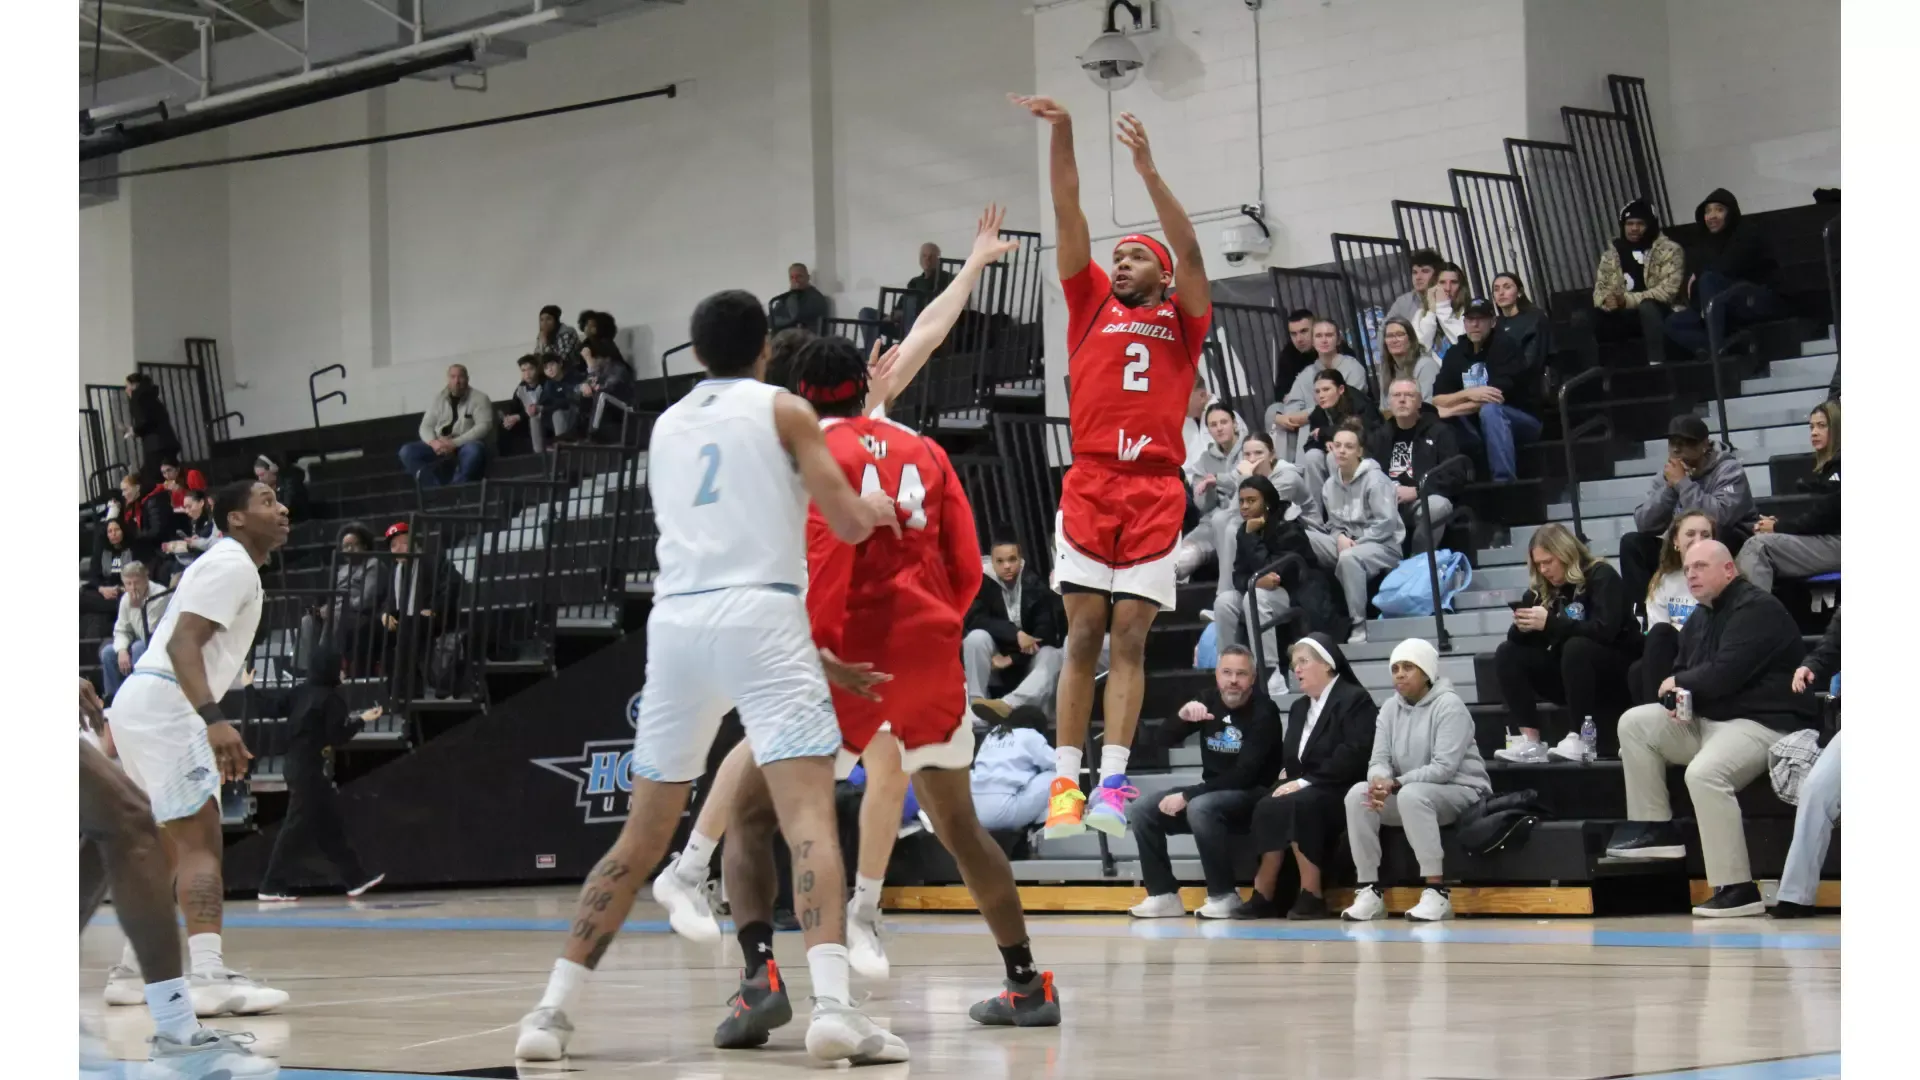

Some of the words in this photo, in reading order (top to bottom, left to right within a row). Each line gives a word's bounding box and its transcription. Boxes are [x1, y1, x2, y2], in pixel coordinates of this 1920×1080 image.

[1101, 321, 1176, 341] CALDWELL
[1122, 342, 1150, 392] 2
[691, 442, 722, 508] 2
